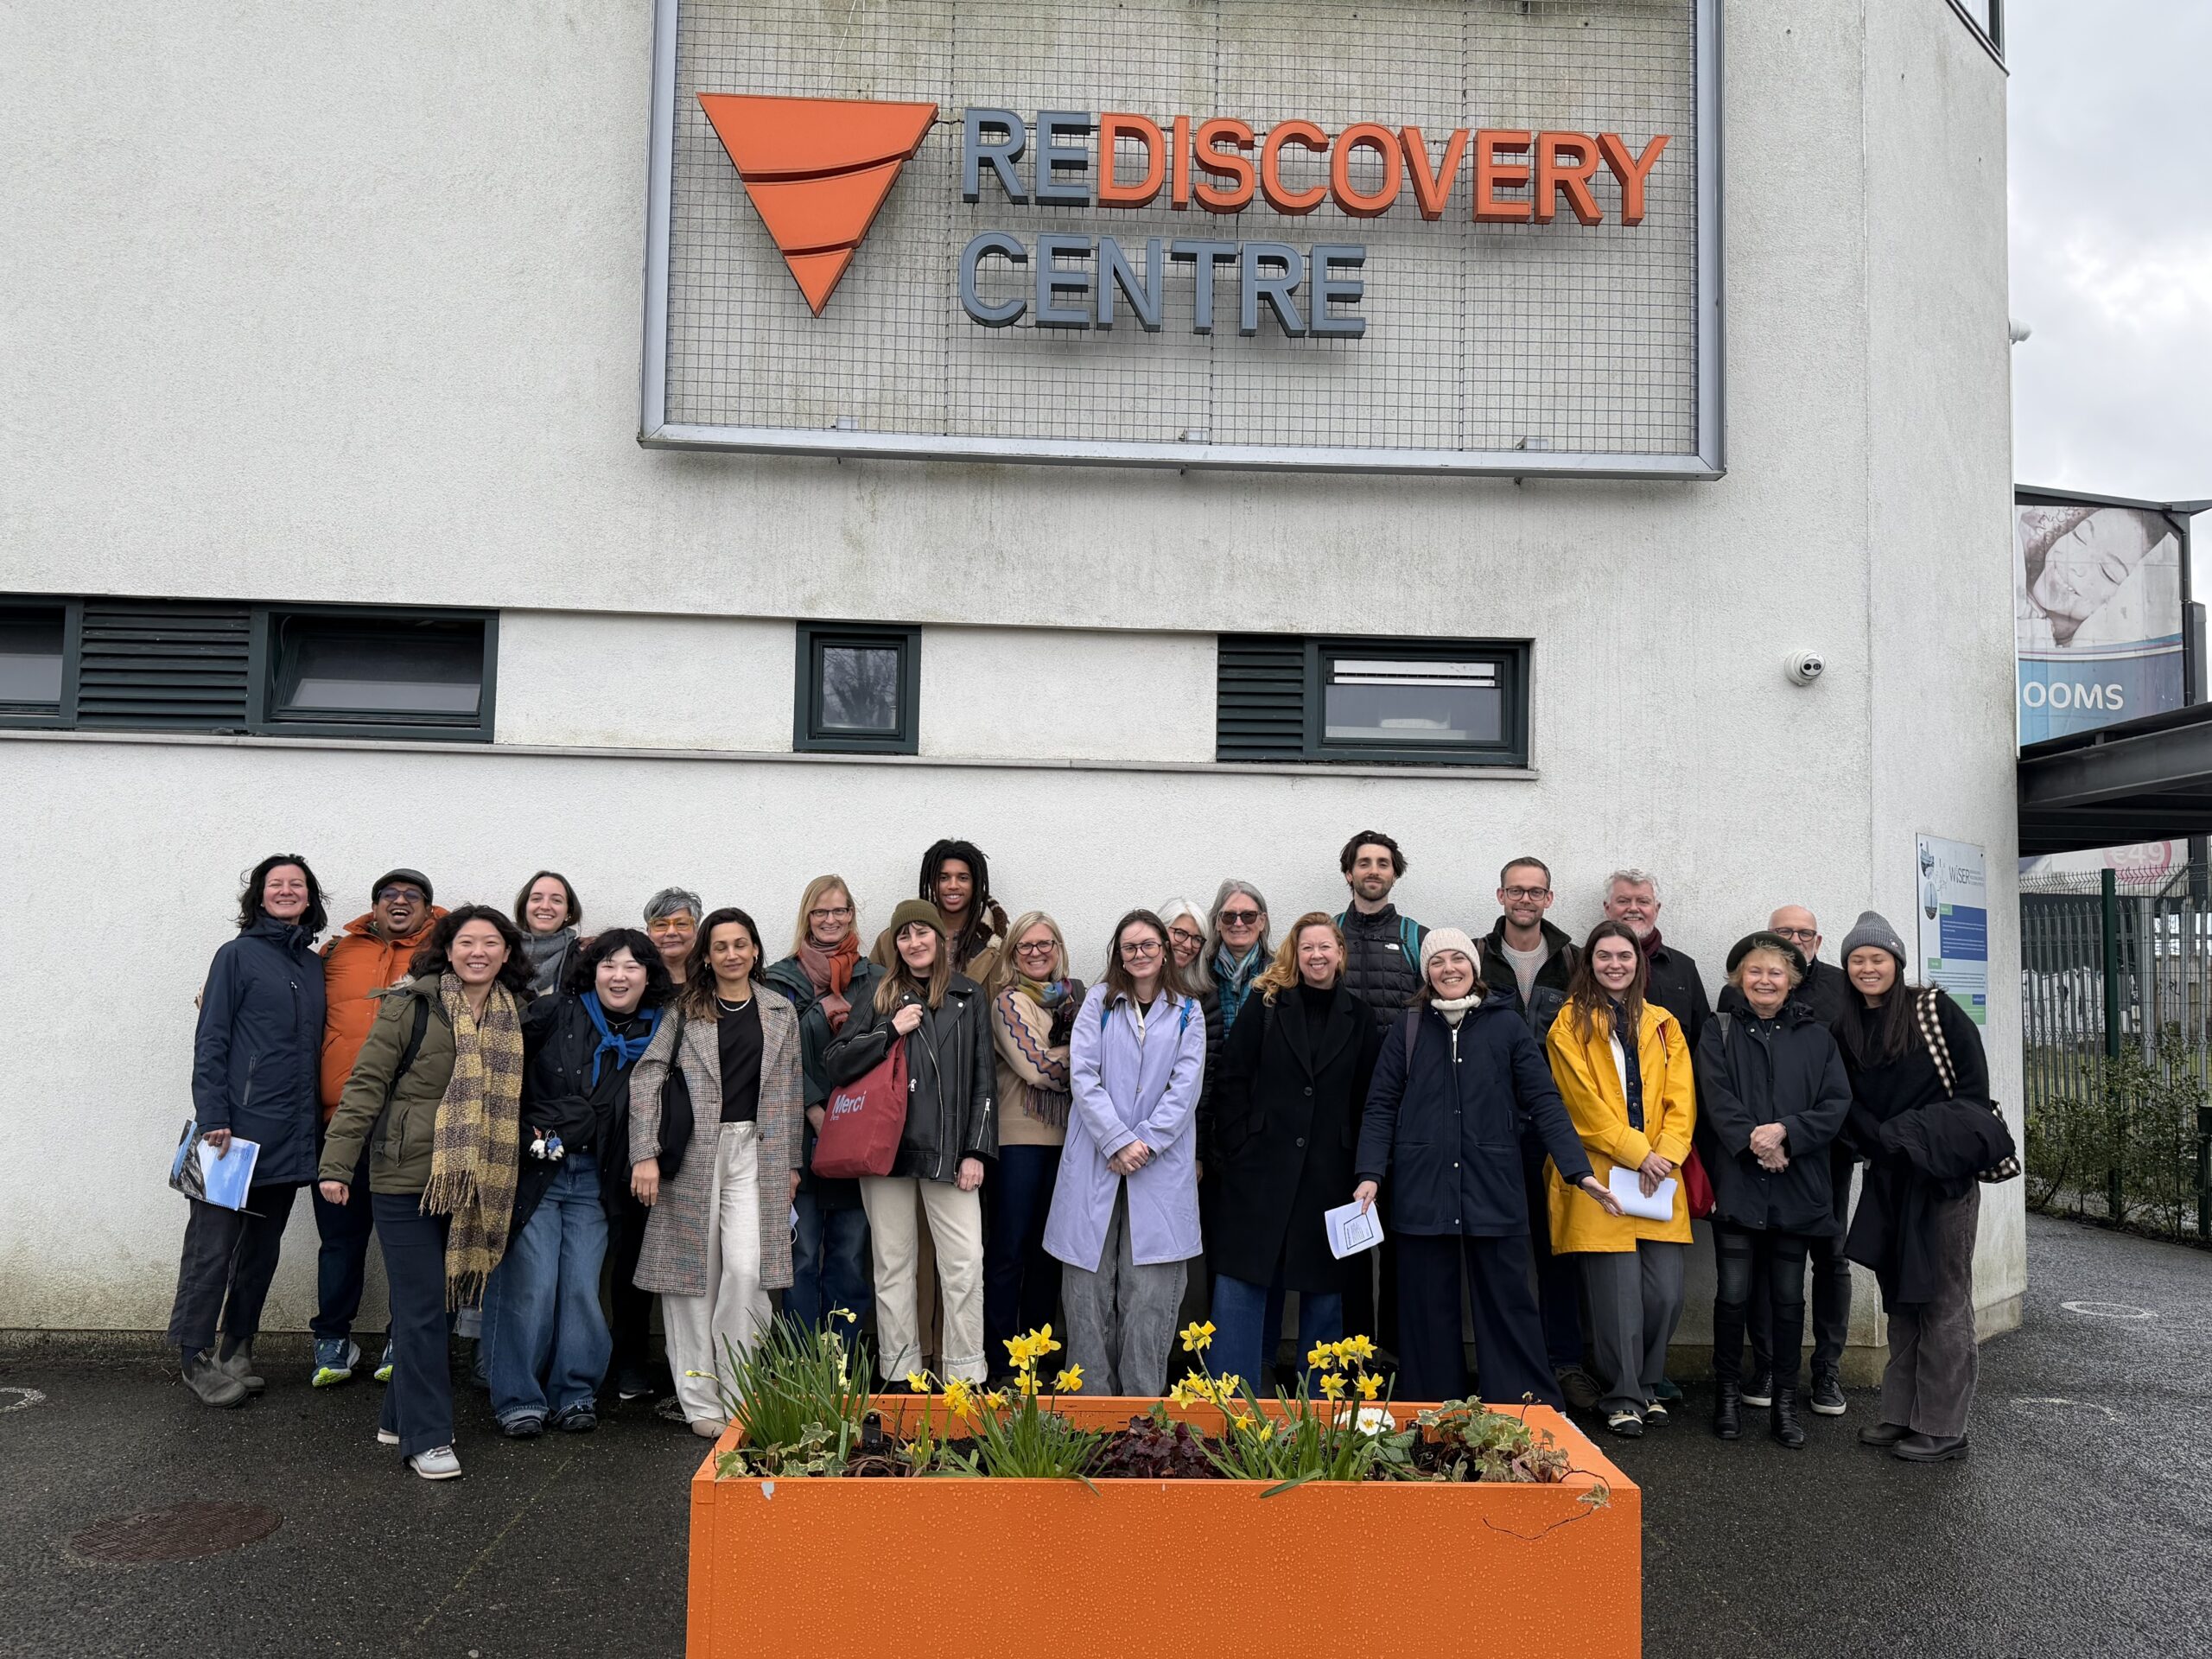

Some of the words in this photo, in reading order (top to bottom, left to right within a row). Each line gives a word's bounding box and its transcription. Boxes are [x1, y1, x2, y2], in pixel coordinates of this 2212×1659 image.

[963, 106, 1671, 226] REDISCOVERY
[958, 232, 1366, 339] CENTRE
[2023, 681, 2124, 710] OOMS
[832, 1090, 867, 1114] Merci
